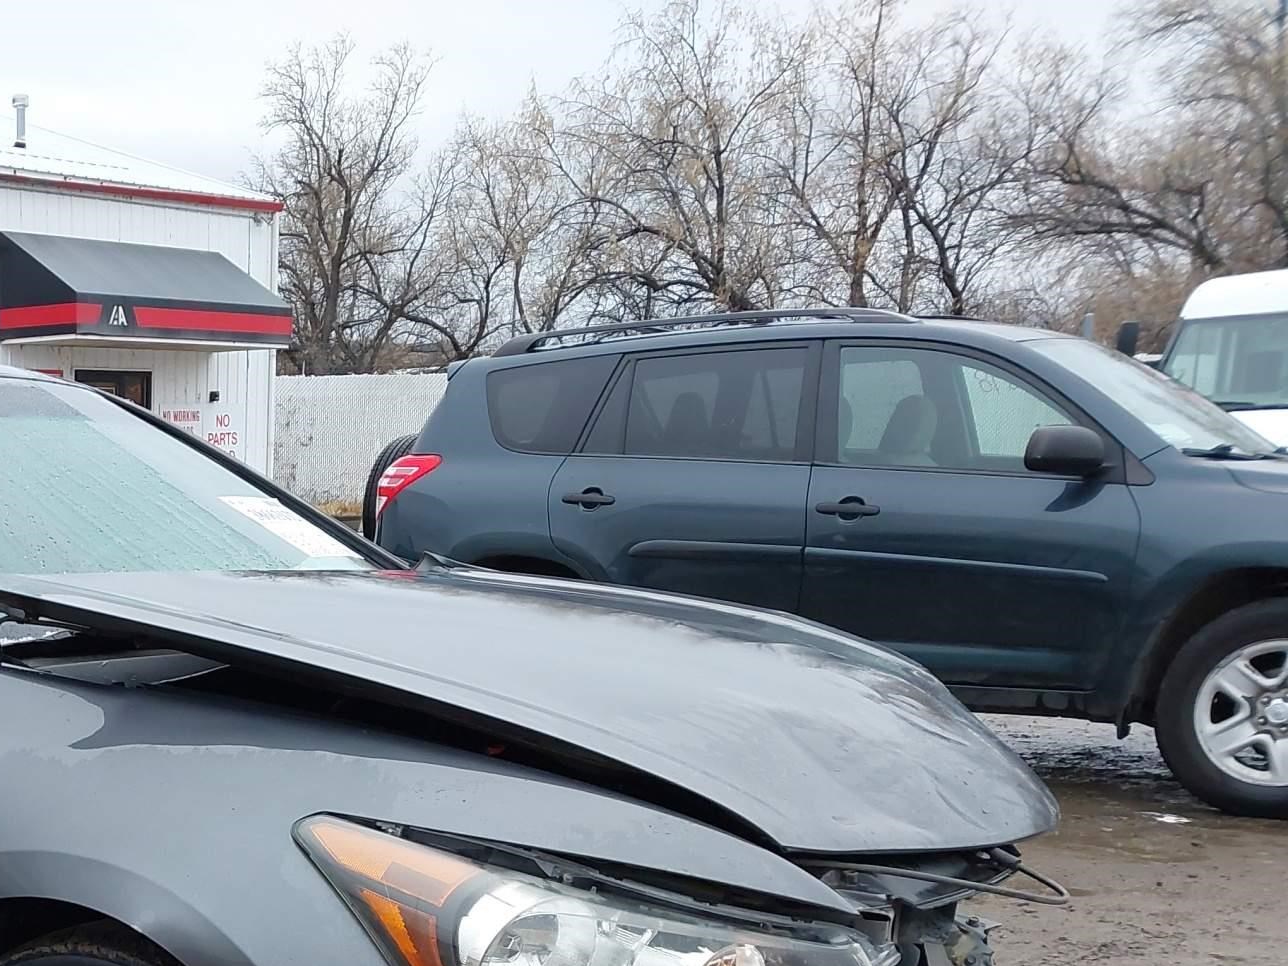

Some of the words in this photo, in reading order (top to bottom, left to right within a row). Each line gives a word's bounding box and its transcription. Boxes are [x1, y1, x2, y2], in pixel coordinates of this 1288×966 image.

[172, 409, 200, 422] WORKING
[215, 413, 231, 428] NO
[207, 431, 238, 446] PARTS
